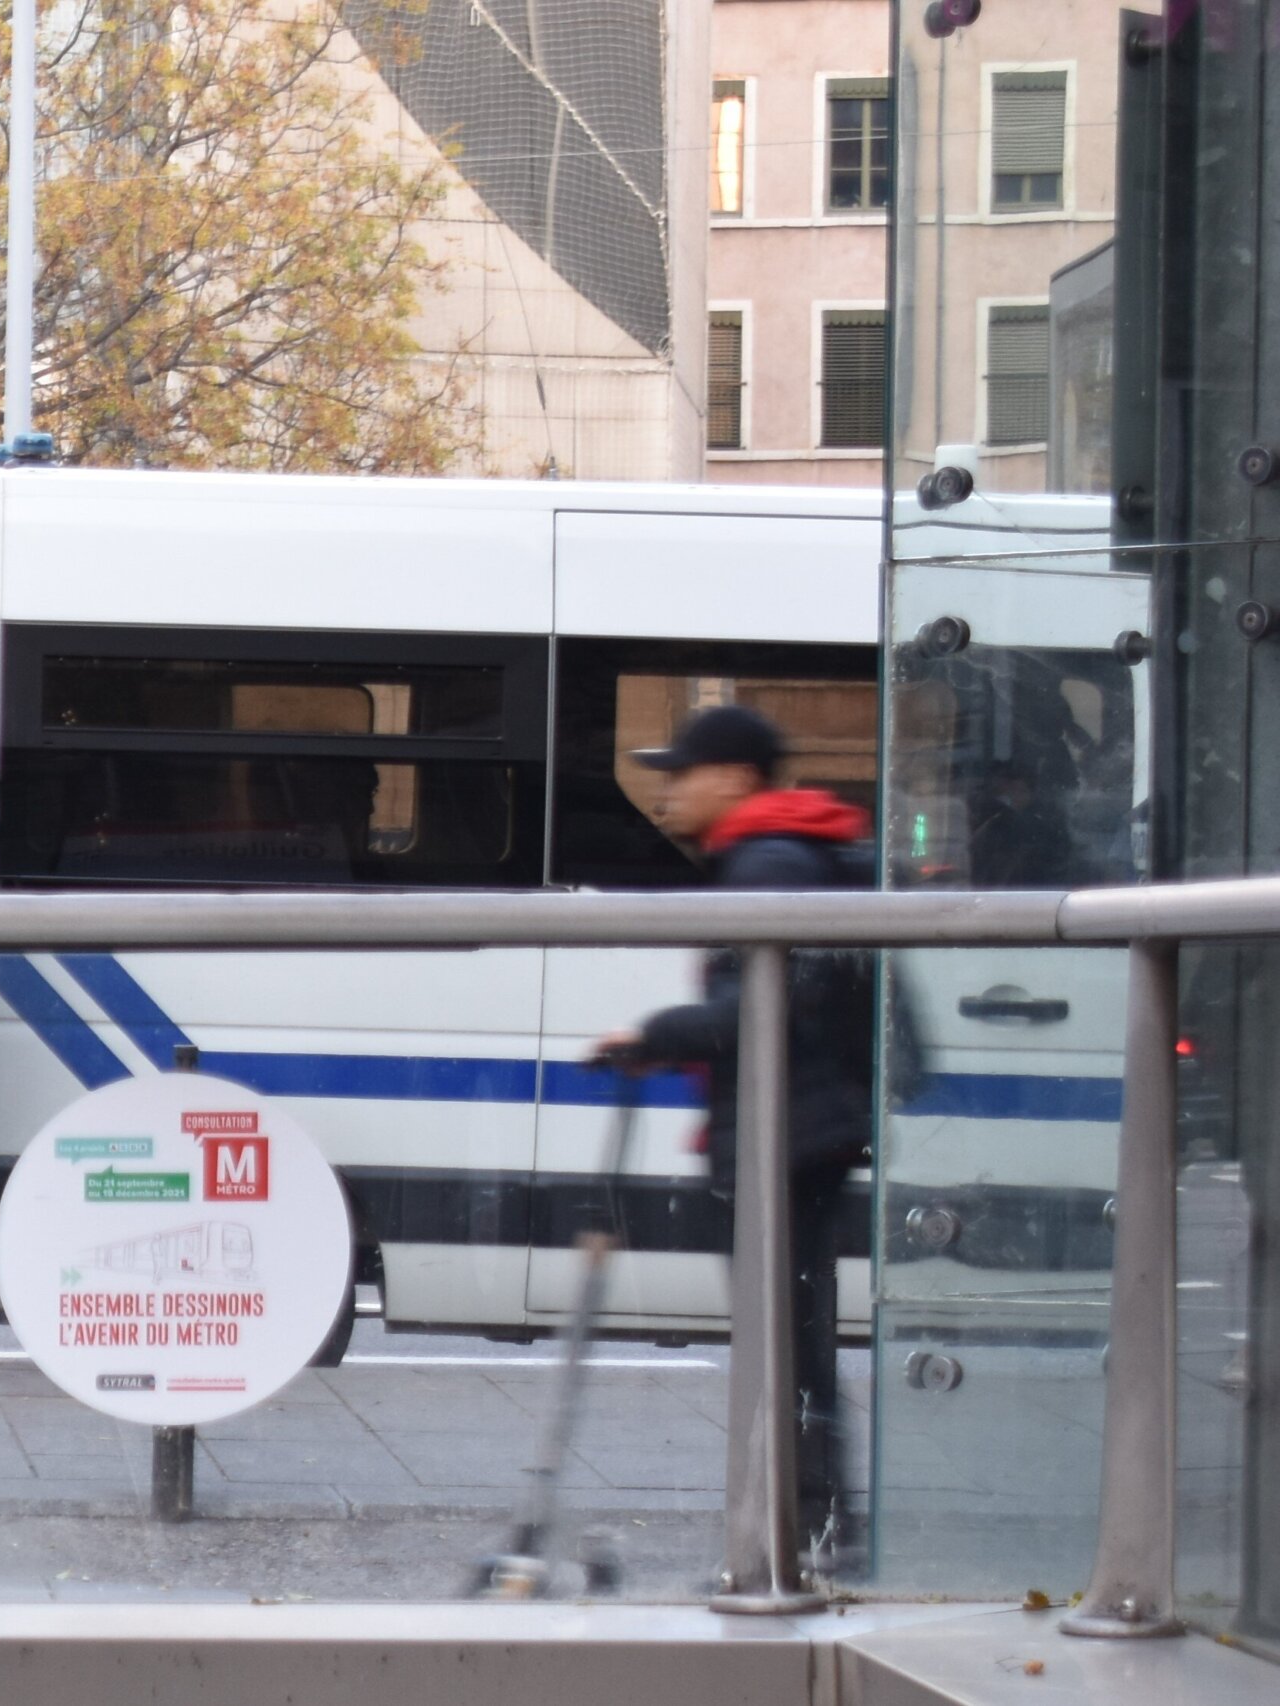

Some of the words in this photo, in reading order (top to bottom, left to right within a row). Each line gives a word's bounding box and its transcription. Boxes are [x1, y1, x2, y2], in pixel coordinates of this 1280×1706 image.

[185, 1116, 253, 1129] CONSULTATION
[216, 1145, 256, 1184] M
[88, 1179, 102, 1187] Du
[116, 1178, 165, 1189] septembre
[115, 1188, 161, 1198] décembre
[162, 1188, 186, 1198] 2021
[59, 1293, 156, 1317] ENSEMBLE
[162, 1293, 264, 1317] DESSINONS
[59, 1322, 139, 1346] L'AVENIR
[146, 1322, 169, 1346] DU
[176, 1319, 238, 1346] MÉTRO
[103, 1375, 144, 1387] SYTRAL
